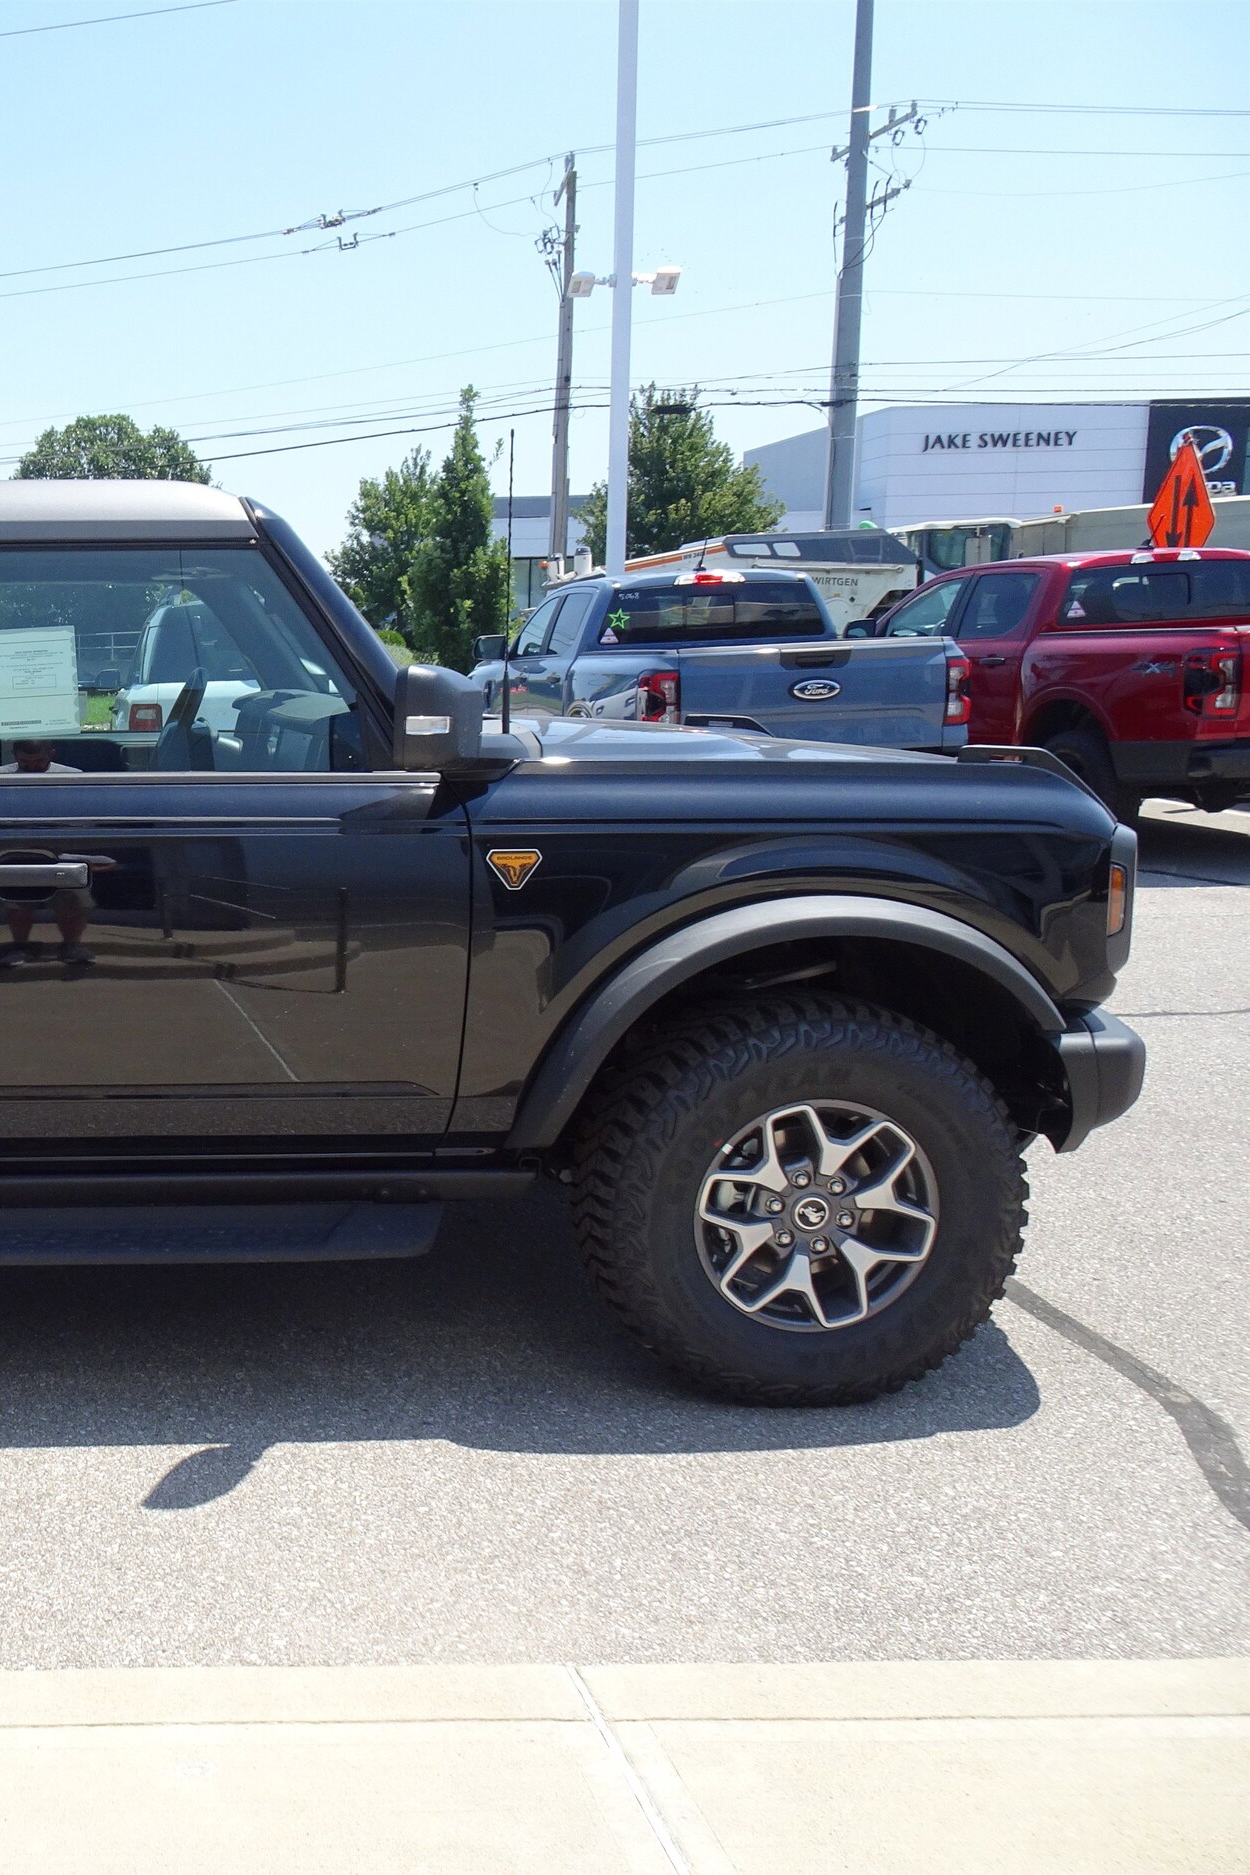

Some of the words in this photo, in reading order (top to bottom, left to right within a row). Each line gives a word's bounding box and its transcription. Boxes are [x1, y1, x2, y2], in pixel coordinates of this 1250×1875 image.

[922, 433, 971, 452] JAKE
[977, 430, 1077, 448] SWEENEY
[812, 576, 859, 587] WIRTGEN
[804, 683, 830, 695] Ford
